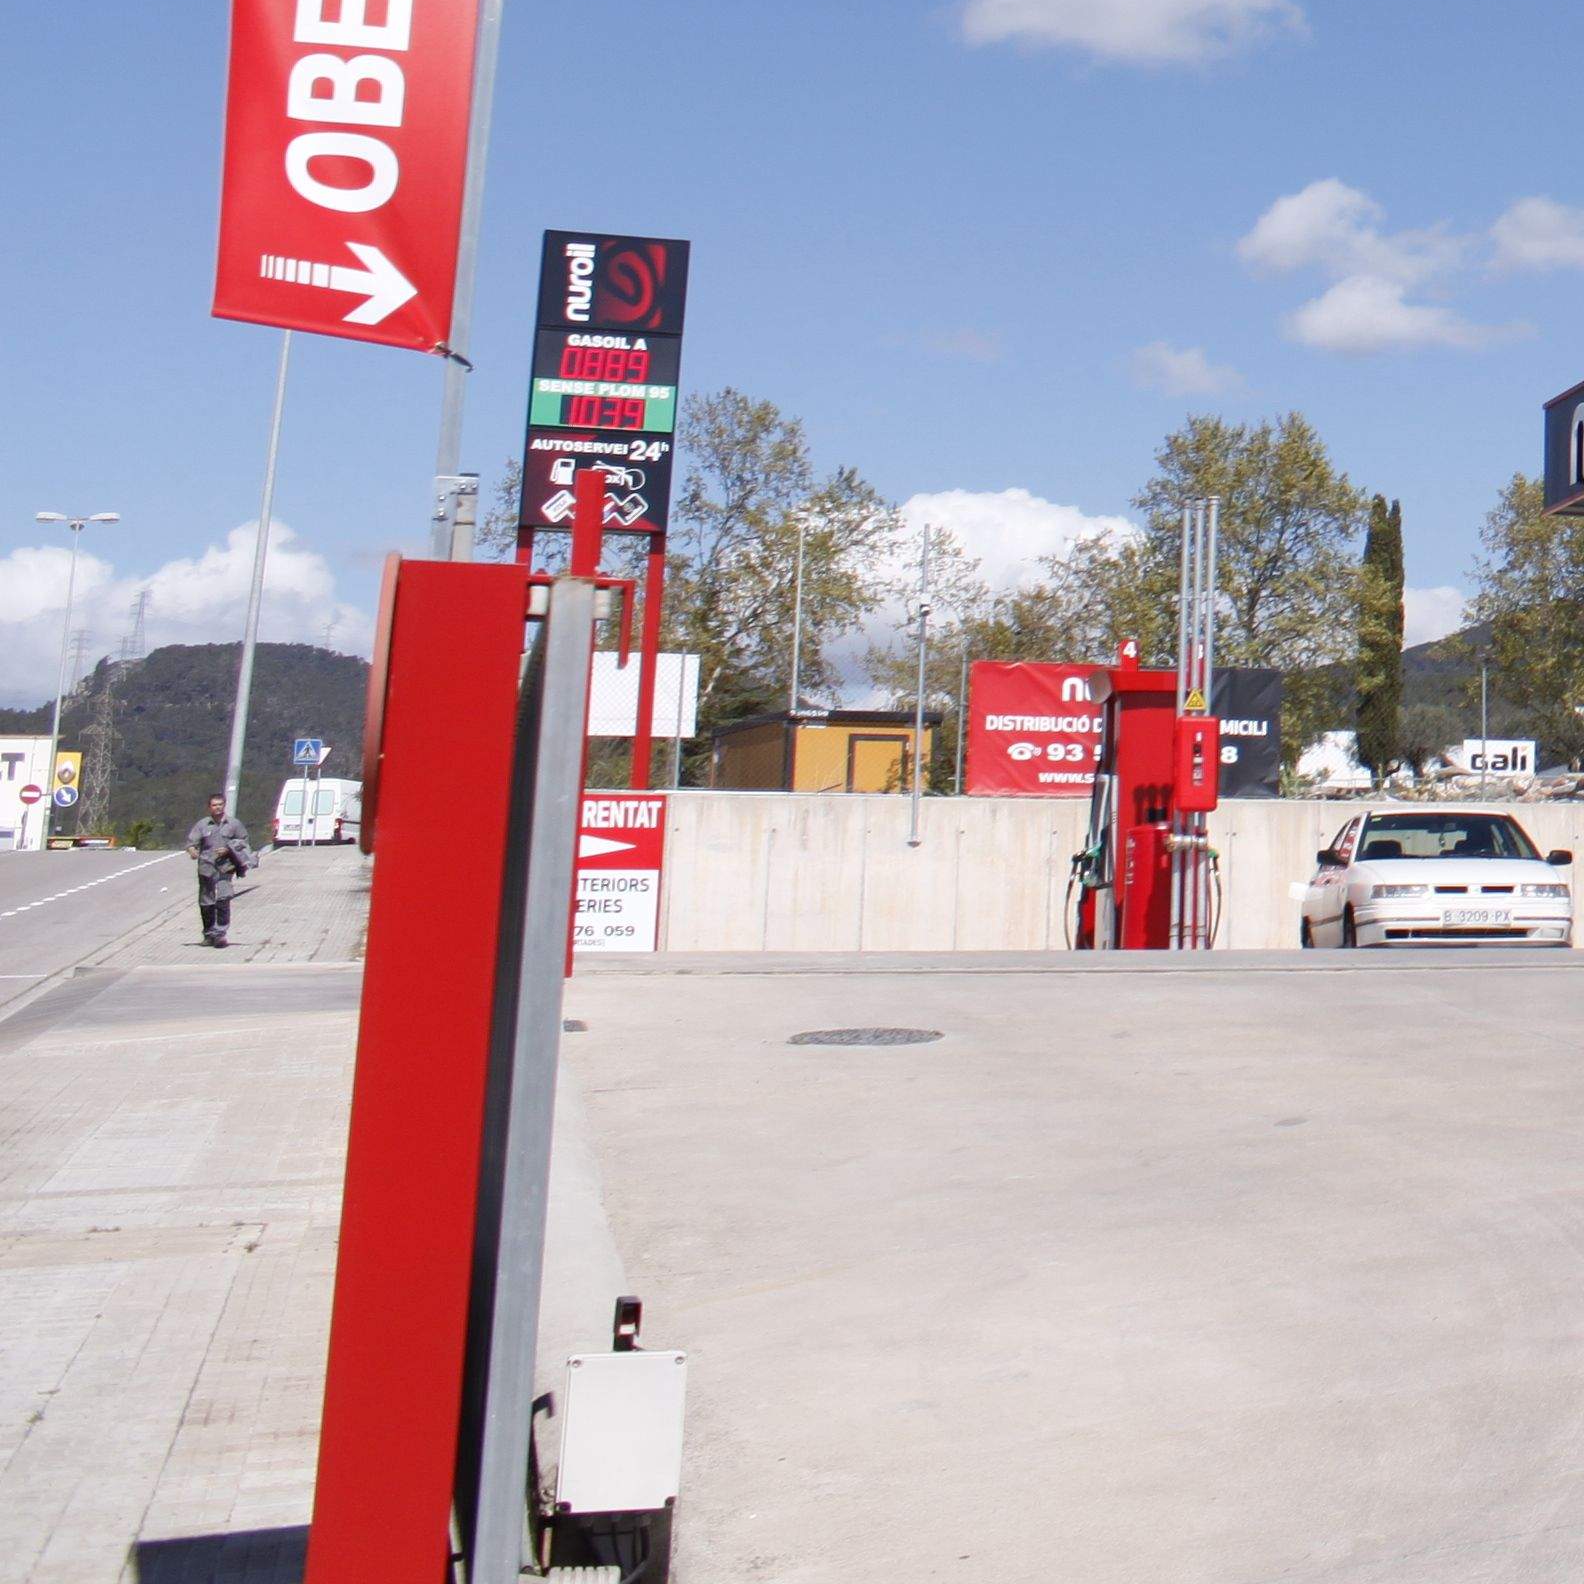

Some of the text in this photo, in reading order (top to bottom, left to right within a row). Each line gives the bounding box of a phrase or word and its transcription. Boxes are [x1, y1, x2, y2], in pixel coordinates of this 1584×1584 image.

[565, 243, 596, 321] nuroil
[567, 334, 648, 351] GASOIL A
[538, 379, 670, 399] SENSE PLOM 95
[530, 438, 670, 462] AUTOSERVEI 24h
[1122, 642, 1137, 658] 4
[985, 714, 1089, 733] DISTRIBUCIÓ
[1219, 719, 1268, 736] MICILI
[1046, 743, 1085, 762] 93
[1219, 746, 1239, 763] 8
[1038, 771, 1095, 784] www.s
[581, 800, 662, 828] RENTAT
[580, 877, 650, 892] TERIORS
[577, 898, 623, 913] ERIES
[574, 925, 635, 937] 76 059
